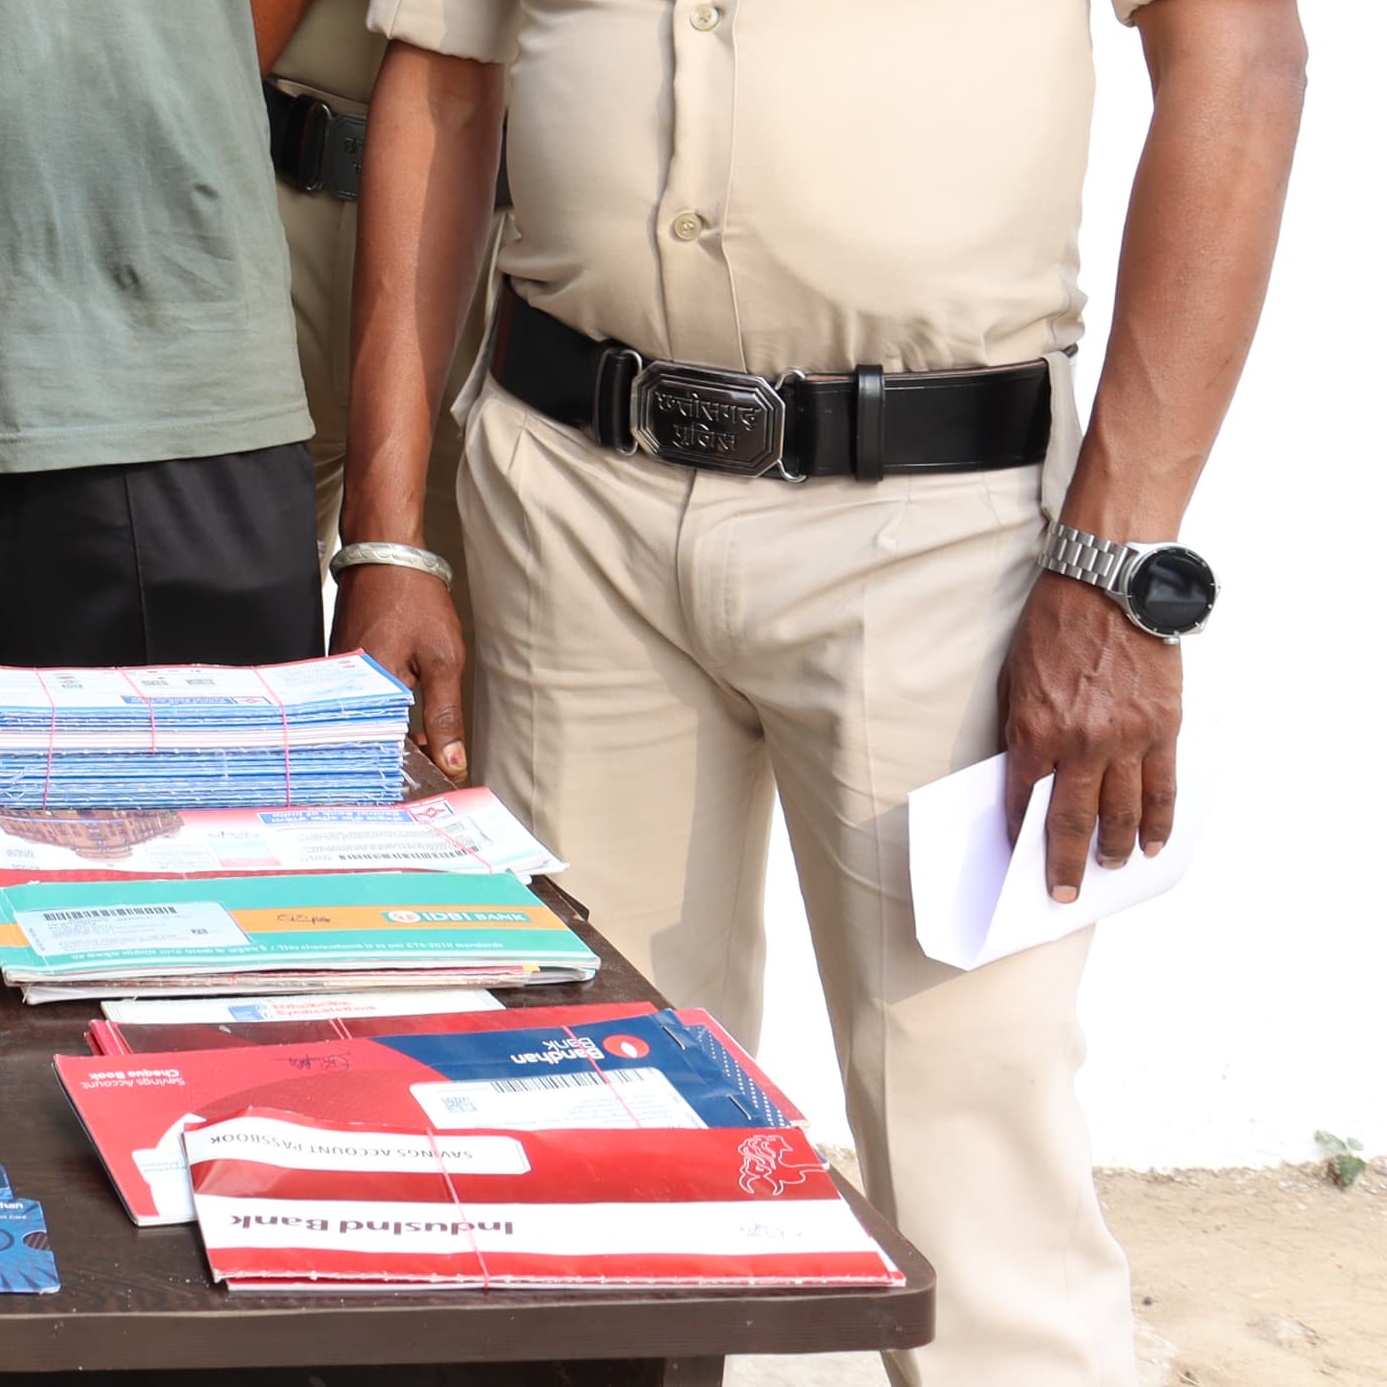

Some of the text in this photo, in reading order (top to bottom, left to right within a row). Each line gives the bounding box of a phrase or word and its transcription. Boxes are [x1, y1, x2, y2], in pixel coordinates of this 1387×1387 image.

[422, 910, 469, 923] IDBI
[510, 1045, 605, 1065] Bandhan
[209, 1133, 302, 1155] PASSBOOK
[306, 1142, 391, 1159] ACCOUNT
[230, 1213, 329, 1232] Bank
